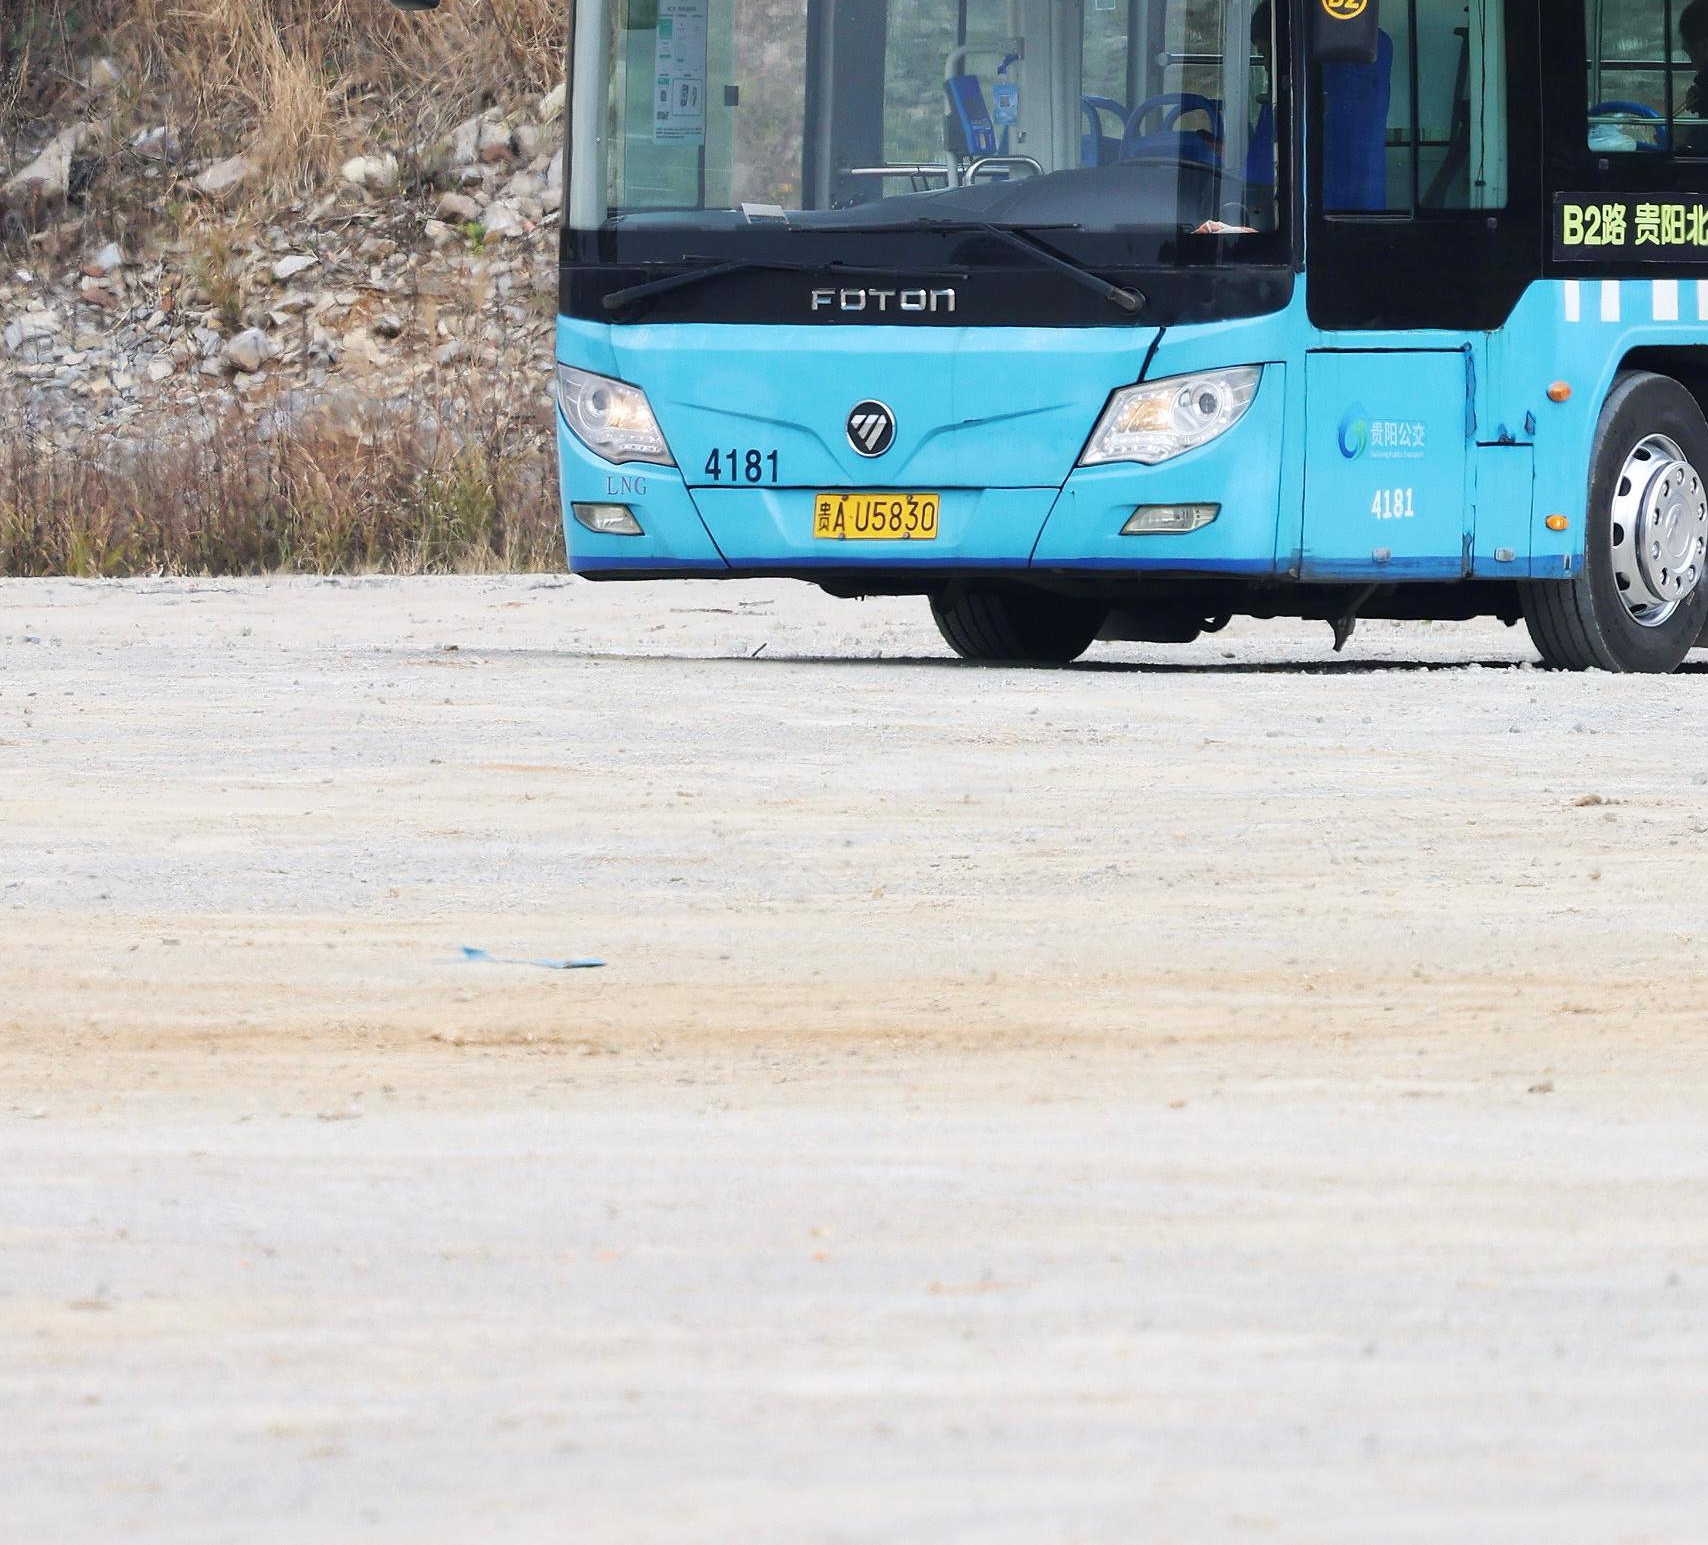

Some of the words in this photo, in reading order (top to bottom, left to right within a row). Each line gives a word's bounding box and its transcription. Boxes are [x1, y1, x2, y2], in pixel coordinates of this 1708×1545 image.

[1563, 203, 1627, 245] B2路
[811, 288, 956, 312] FOTON
[1371, 422, 1425, 447] 贵阳公交
[705, 448, 778, 483] 4181
[607, 476, 647, 496] LNG
[1371, 487, 1415, 520] 4181
